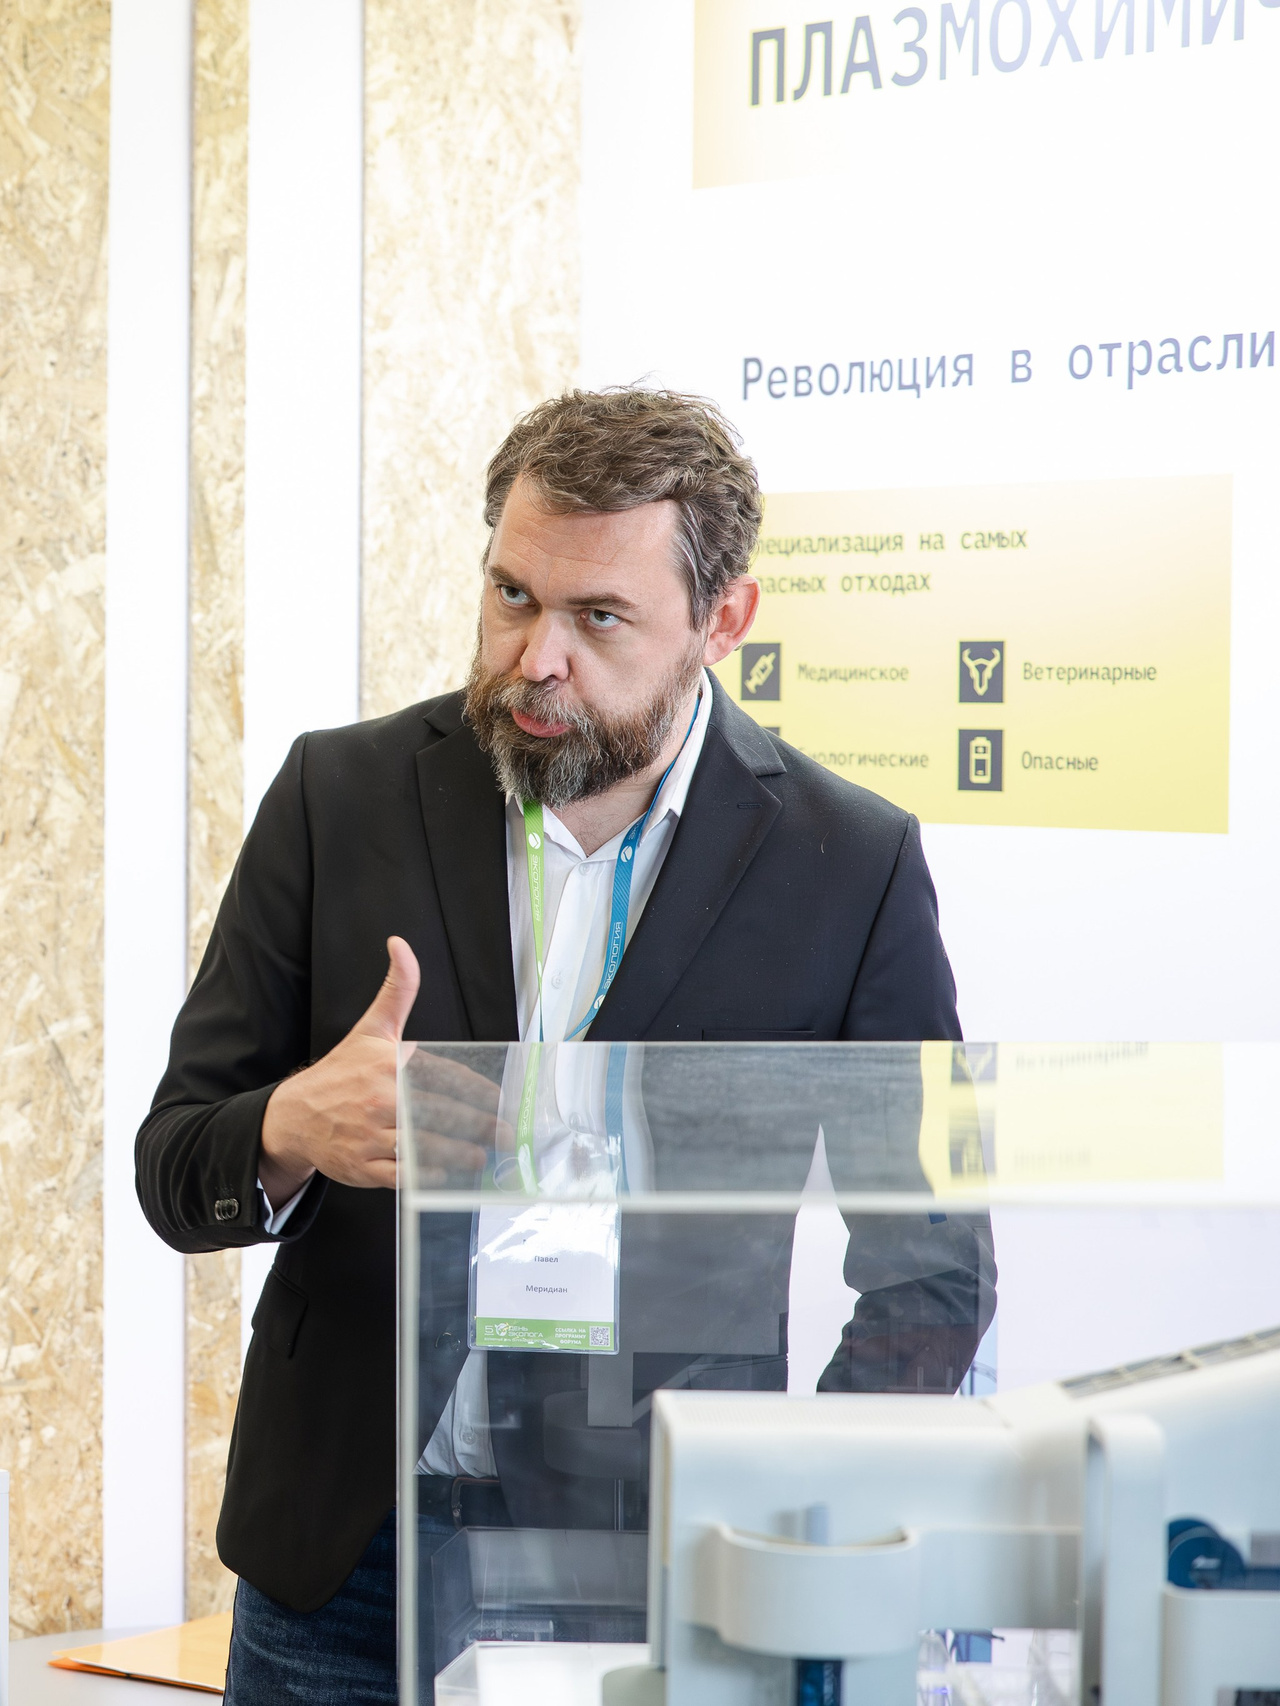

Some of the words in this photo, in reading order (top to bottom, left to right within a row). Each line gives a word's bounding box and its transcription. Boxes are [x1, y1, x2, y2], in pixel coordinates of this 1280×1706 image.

[748, 0, 1280, 107] ПЛАЗМОХИМИ
[741, 351, 975, 399] Революция
[1010, 348, 1034, 385] в
[1067, 330, 1276, 390] отрасли
[758, 532, 904, 558] пециализация
[919, 532, 946, 551] на
[960, 529, 1028, 550] самых
[758, 574, 826, 594] пасных
[840, 571, 932, 595] отходах
[797, 662, 909, 684] Медицинское
[1022, 661, 1158, 686] Ветеринарные
[1021, 751, 1099, 772] Опасные
[603, 921, 622, 989] ЭКОЛОГИЯ
[534, 1255, 559, 1263] Павел
[525, 1284, 568, 1294] Меридиан
